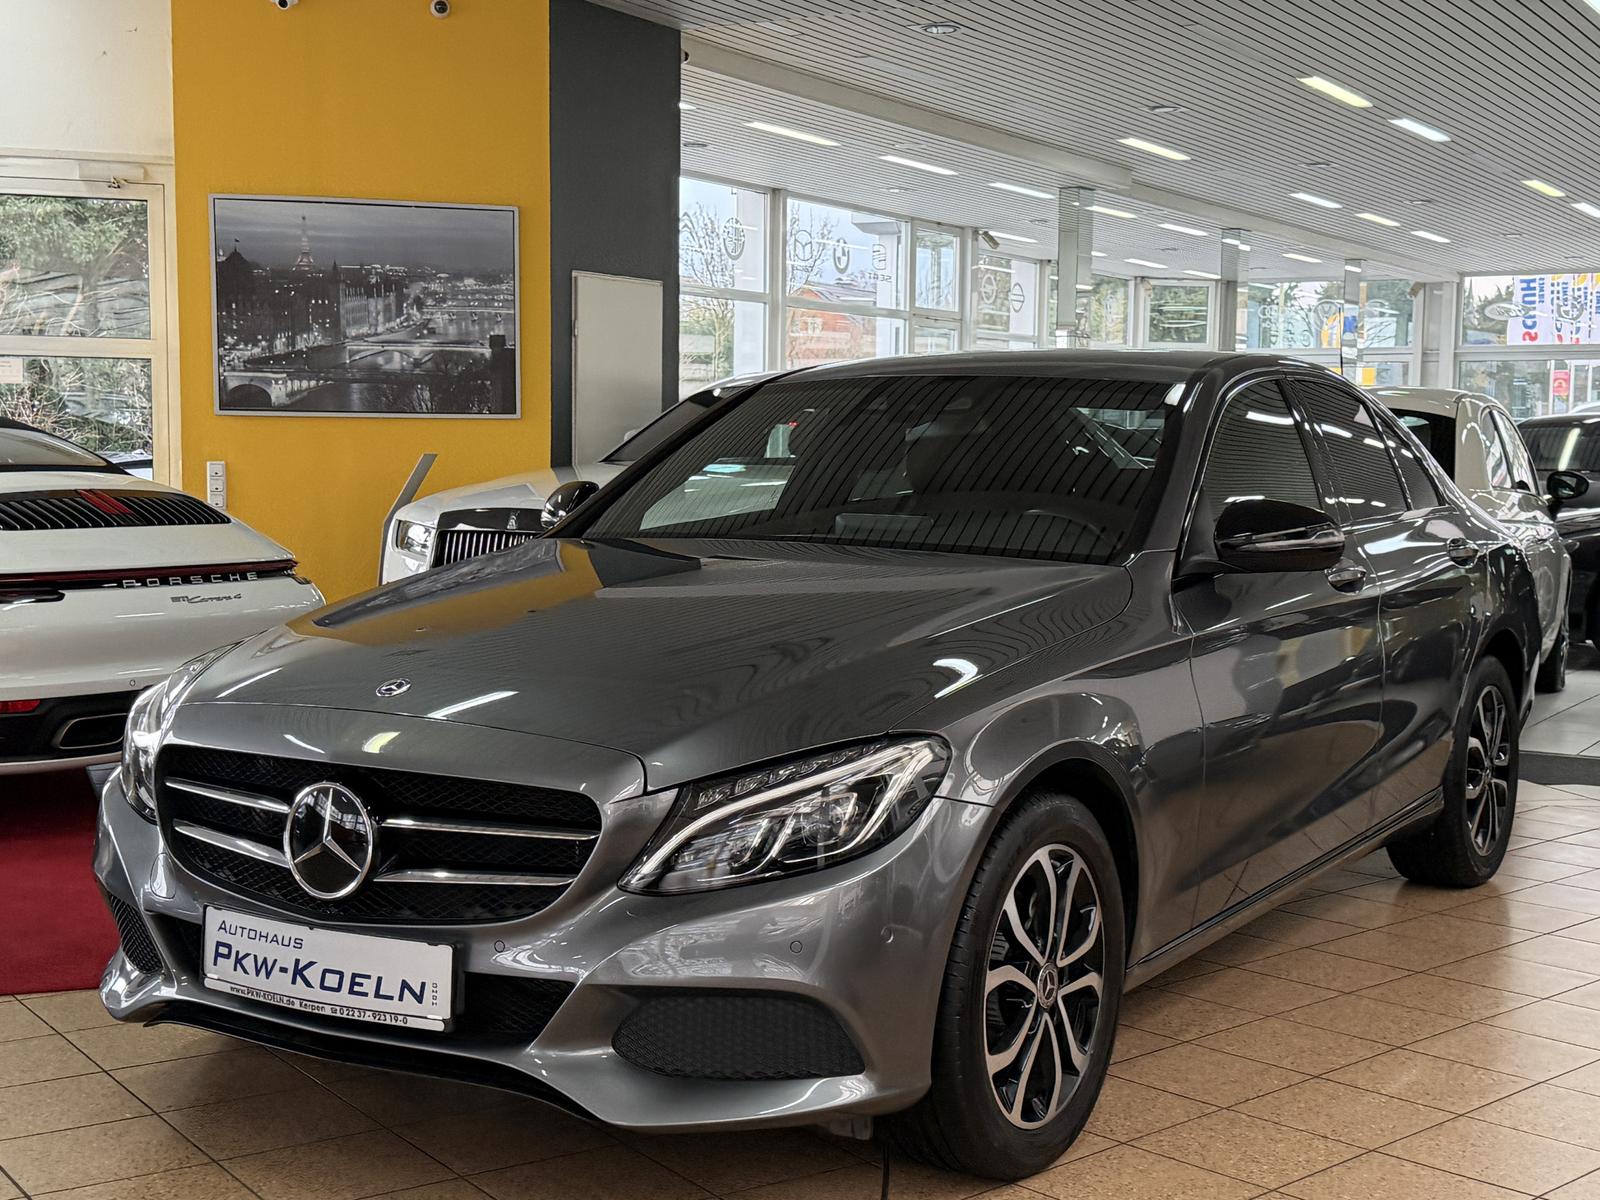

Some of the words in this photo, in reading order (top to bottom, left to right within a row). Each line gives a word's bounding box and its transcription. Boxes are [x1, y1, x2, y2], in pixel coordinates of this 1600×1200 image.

[122, 572, 258, 588] PORSCHE
[217, 920, 304, 950] AUTOHAUS
[212, 940, 426, 1005] PKW-KOELN
[299, 1001, 326, 1014] Kerpen
